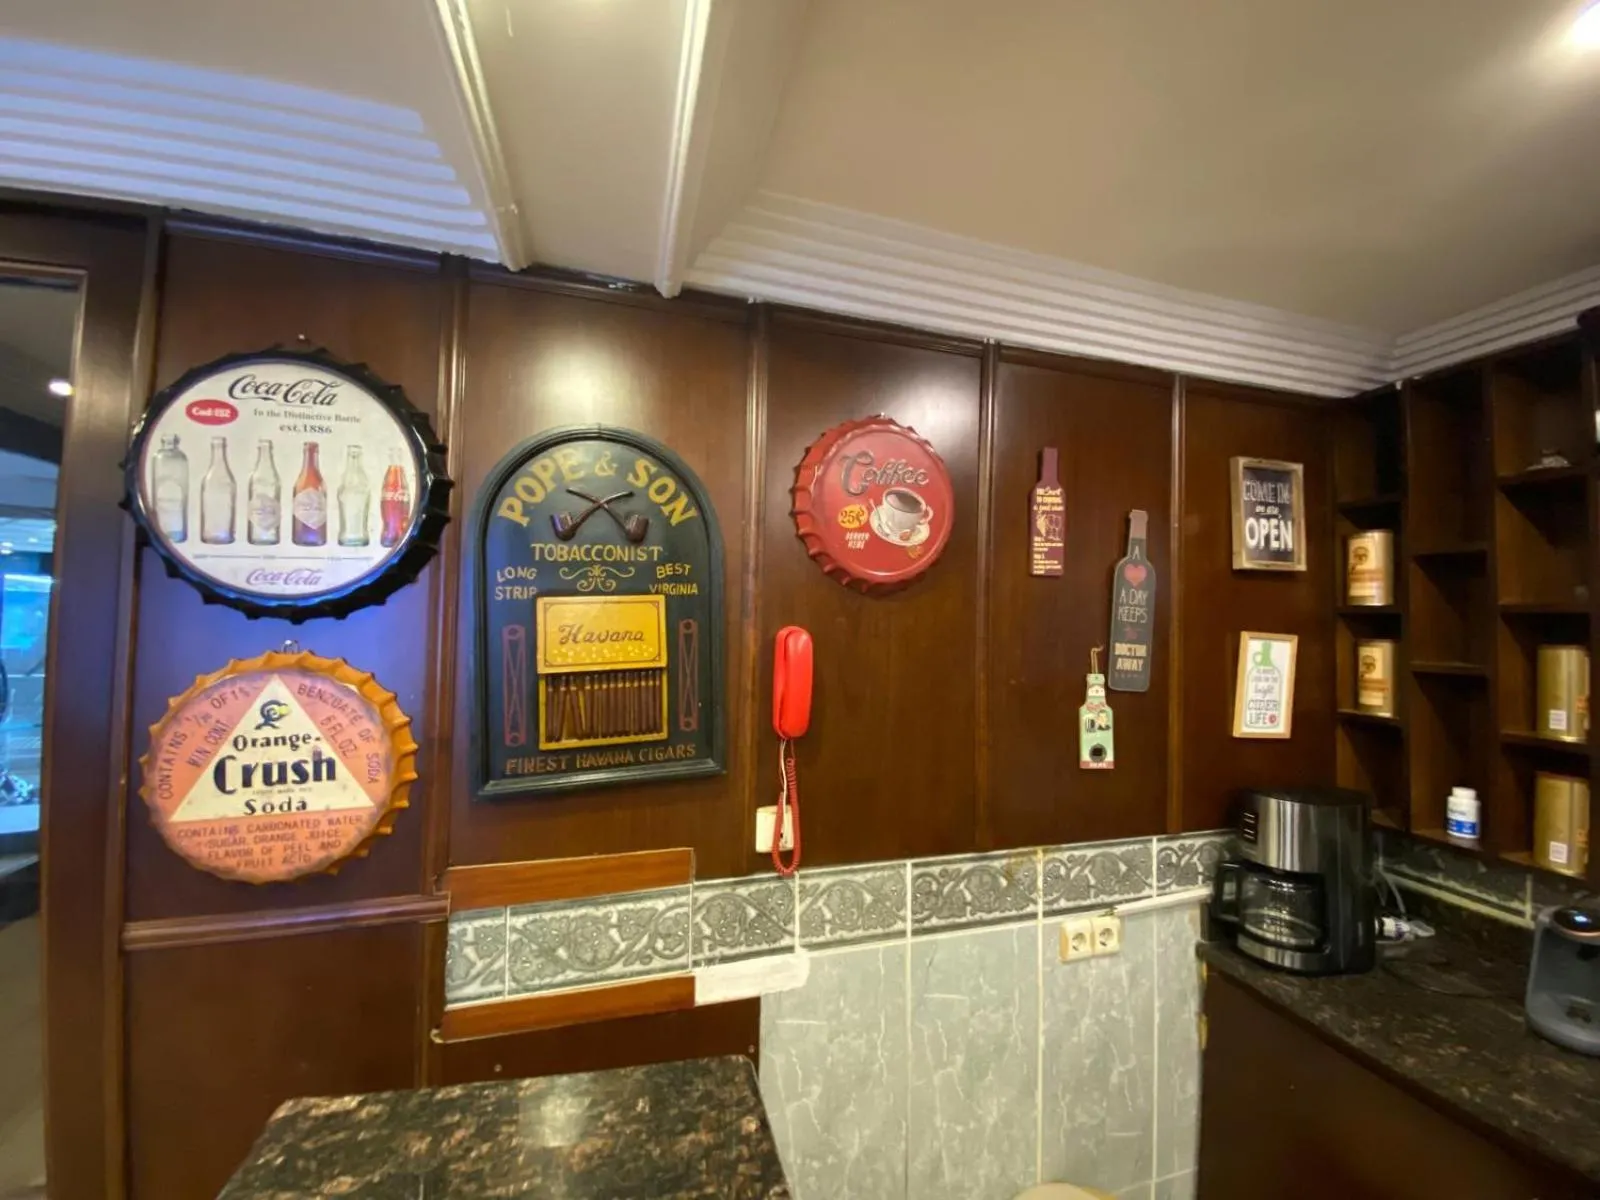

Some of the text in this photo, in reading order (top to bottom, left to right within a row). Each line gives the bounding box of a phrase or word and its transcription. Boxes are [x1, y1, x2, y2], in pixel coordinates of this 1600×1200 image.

[228, 374, 343, 408] Coca-Cola
[839, 451, 929, 496] Coffee
[497, 446, 700, 528] POPE & SON
[1245, 517, 1293, 551] OPEN
[530, 543, 663, 563] TOBACCONIST
[1132, 545, 1141, 560] A
[246, 568, 325, 586] Coca-Cola
[496, 565, 537, 583] LONG
[656, 562, 692, 579] BEST
[495, 586, 538, 602] STRIP
[648, 583, 699, 596] VIRGINIA
[1119, 588, 1127, 603] A
[1118, 606, 1148, 624] KEEPS
[558, 624, 647, 646] Havana
[1115, 658, 1144, 671] AWAY
[158, 731, 188, 799] CONTAINS
[505, 744, 697, 775] FINEST HAVANA CIGARS
[213, 748, 337, 795] Crush
[243, 796, 308, 816] Soda
